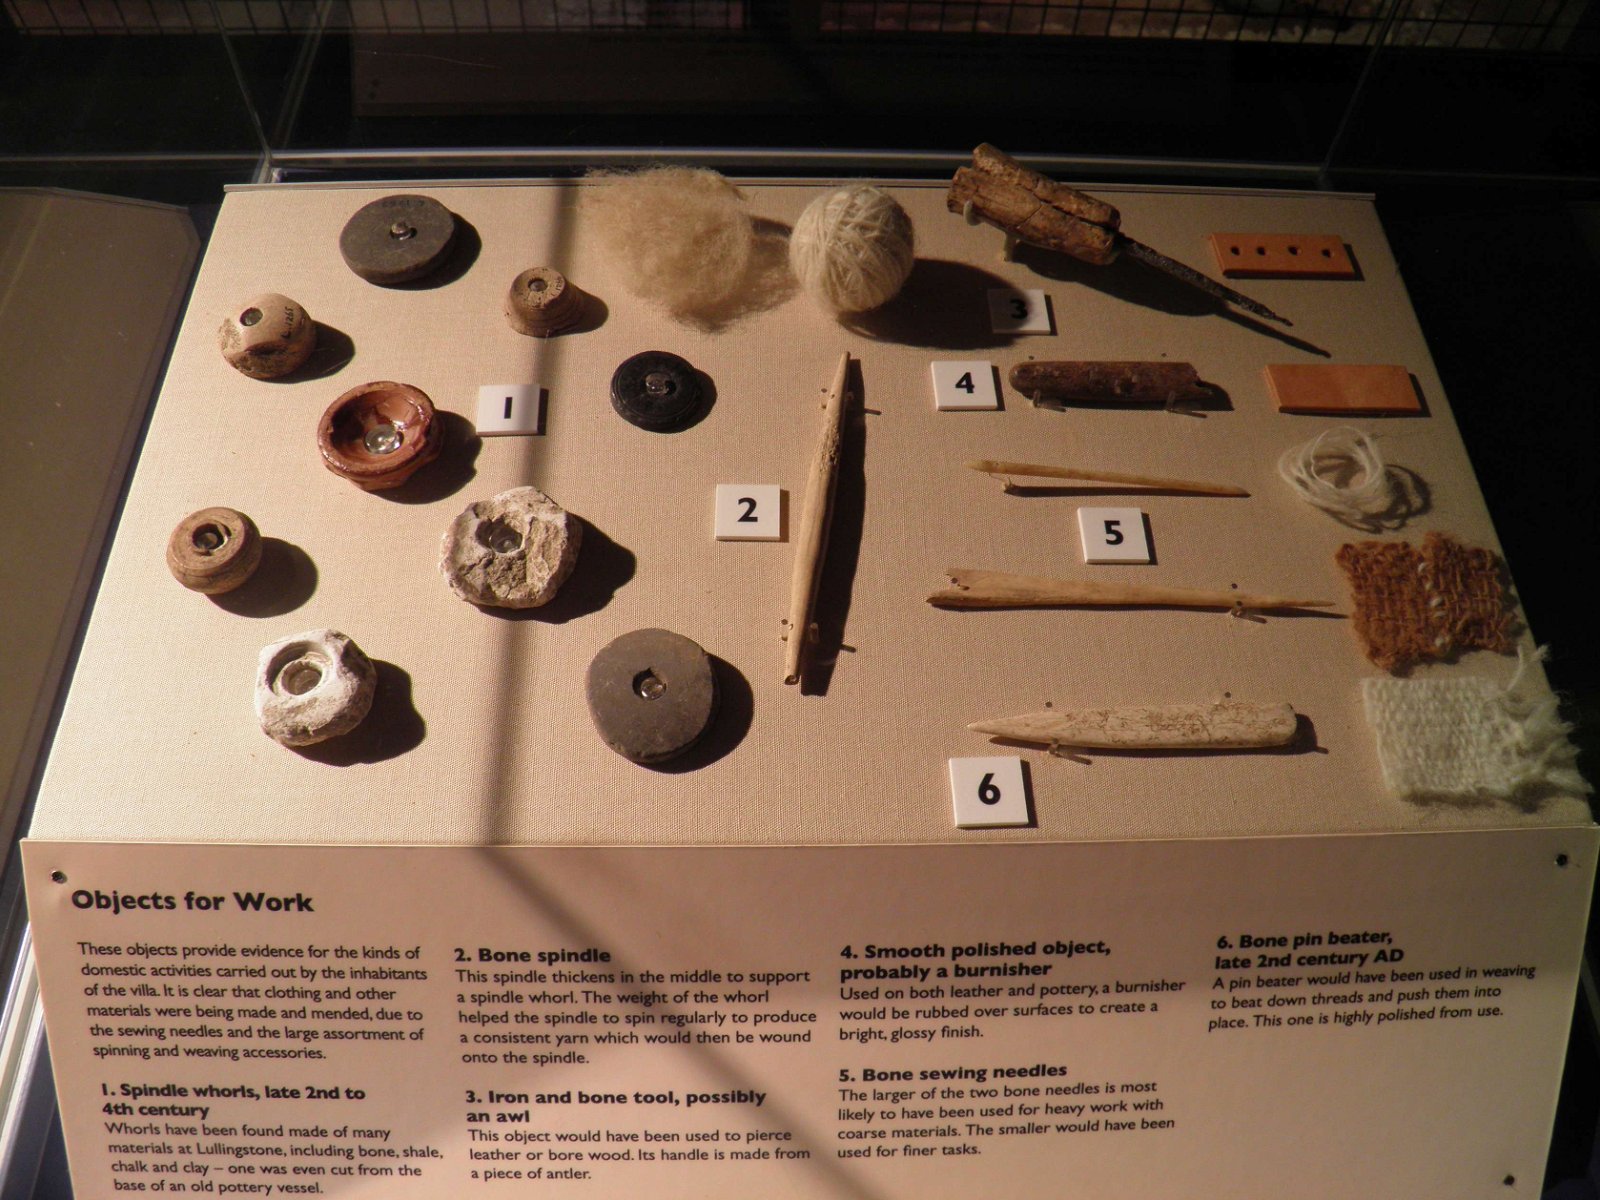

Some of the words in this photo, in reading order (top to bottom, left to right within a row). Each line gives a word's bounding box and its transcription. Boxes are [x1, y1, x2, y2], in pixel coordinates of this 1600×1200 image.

[1010, 299, 1028, 320] 3
[954, 371, 976, 395] 4
[503, 396, 513, 420] 1
[737, 497, 759, 523] 2
[1103, 519, 1125, 546] 5
[977, 772, 1002, 806] 6
[71, 889, 177, 915] Objects
[183, 891, 226, 911] for
[232, 891, 315, 912] Work
[76, 941, 122, 956] These
[126, 942, 178, 959] objects
[182, 943, 237, 960] provide
[240, 944, 304, 958] evidence
[307, 944, 330, 958] for
[333, 945, 359, 959] the
[362, 945, 401, 960] kinds
[404, 946, 421, 960] of
[1216, 935, 1234, 950] 6.
[1239, 934, 1289, 949] Bone
[1292, 932, 1323, 951] pin
[1327, 930, 1393, 946] beater,
[454, 947, 472, 962] 2.
[478, 947, 532, 963] Bone
[537, 947, 612, 967] spindle
[840, 945, 859, 959] 4.
[864, 943, 946, 959] Smooth
[951, 941, 1037, 962] polished
[1042, 940, 1111, 959] object,
[1214, 955, 1252, 970] late
[1256, 953, 1292, 968] 2nd
[1296, 952, 1370, 968] century
[1372, 948, 1405, 964] AD
[81, 962, 147, 976] domestic
[150, 964, 212, 977] activities
[216, 964, 267, 978] carried
[270, 968, 297, 979] out
[300, 965, 318, 983] by
[321, 965, 346, 979] the
[349, 966, 428, 981] inhabitants
[454, 969, 488, 983] This
[493, 969, 547, 987] spindle
[551, 970, 616, 984] thickens
[619, 970, 635, 984] in
[639, 970, 665, 984] the
[670, 969, 722, 983] middle
[726, 972, 744, 983] to
[749, 971, 811, 986] support
[840, 964, 931, 984] probably
[936, 967, 949, 978] a
[954, 962, 1053, 978] burnisher
[840, 986, 880, 1000] Used
[884, 989, 904, 1000] on
[909, 985, 945, 999] both
[950, 984, 1004, 998] leather
[1008, 983, 1035, 997] and
[1039, 984, 1099, 1000] pottery,
[1101, 984, 1110, 994] a
[1115, 978, 1187, 994] burnisher
[458, 1010, 509, 1027] helped
[513, 1010, 540, 1024] the
[544, 1011, 598, 1028] spindle
[602, 1014, 620, 1024] to
[625, 1011, 655, 1028] spin
[660, 1010, 727, 1028] regularly
[731, 1013, 749, 1023] to
[753, 1010, 817, 1027] produce
[1208, 1016, 1249, 1033] place.
[1252, 1014, 1282, 1027] This
[1287, 1015, 1314, 1026] one
[1318, 1012, 1329, 1024] is
[1333, 1009, 1374, 1027] highly
[1377, 1006, 1436, 1025] polished
[1439, 1005, 1473, 1019] from
[1477, 1006, 1504, 1017] use.
[89, 1023, 114, 1037] the
[117, 1024, 167, 1041] sewing
[169, 1024, 223, 1038] needles
[227, 1025, 253, 1038] and
[256, 1025, 281, 1039] the
[284, 1025, 320, 1043] large
[323, 1030, 406, 1041] assortment
[409, 1027, 425, 1041] of
[92, 1044, 151, 1060] spinning
[153, 1044, 179, 1057] and
[183, 1045, 240, 1062] weaving
[242, 1047, 327, 1059] accessories.
[838, 1068, 856, 1083] 5.
[862, 1068, 914, 1082] Bone
[919, 1066, 988, 1083] sewing
[993, 1063, 1067, 1079] needles
[101, 1083, 116, 1096] 1.
[120, 1083, 189, 1101] Spindle
[192, 1084, 261, 1101] whorls,
[264, 1085, 301, 1099] late
[305, 1085, 341, 1100] 2nd
[344, 1087, 366, 1100] to
[465, 1090, 483, 1104] 3.
[488, 1090, 529, 1104] Iron
[535, 1090, 572, 1104] and
[578, 1090, 628, 1104] bone
[633, 1090, 680, 1107] tool,
[686, 1089, 767, 1108] possibly
[102, 1102, 134, 1116] 4th
[138, 1104, 210, 1121] century
[466, 1112, 490, 1123] an
[496, 1110, 530, 1123] awl
[104, 1122, 161, 1135] Whorls
[165, 1123, 198, 1136] have
[202, 1123, 238, 1136] been
[241, 1124, 284, 1137] found
[288, 1125, 329, 1138] made
[333, 1125, 348, 1138] of
[352, 1129, 391, 1142] many
[467, 1129, 499, 1142] This
[504, 1129, 551, 1145] object
[555, 1130, 601, 1142] would
[606, 1130, 639, 1142] have
[644, 1130, 680, 1142] been
[685, 1129, 720, 1142] used
[724, 1132, 741, 1142] to
[746, 1129, 792, 1145] pierce
[837, 1129, 887, 1140] coarse
[891, 1124, 961, 1138] materials.
[965, 1123, 994, 1136] The
[998, 1122, 1051, 1135] smaller
[1055, 1119, 1100, 1133] would
[1104, 1119, 1136, 1131] have
[1140, 1117, 1175, 1130] been
[108, 1141, 174, 1154] materials
[177, 1145, 193, 1155] at
[196, 1142, 287, 1159] Lullingstone,
[290, 1144, 355, 1161] including
[358, 1144, 400, 1159] bone,
[402, 1145, 443, 1159] shale,
[837, 1145, 871, 1158] used
[876, 1145, 898, 1157] for
[903, 1144, 937, 1157] finer
[942, 1143, 981, 1156] tasks.
[471, 1170, 479, 1179] a
[484, 1167, 522, 1182] piece
[527, 1167, 543, 1179] of
[546, 1167, 592, 1179] antler.
[113, 1178, 146, 1191] base
[150, 1179, 166, 1192] of
[169, 1183, 186, 1192] an
[190, 1180, 214, 1192] old
[218, 1183, 273, 1197] pottery
[277, 1181, 324, 1194] vessel.
